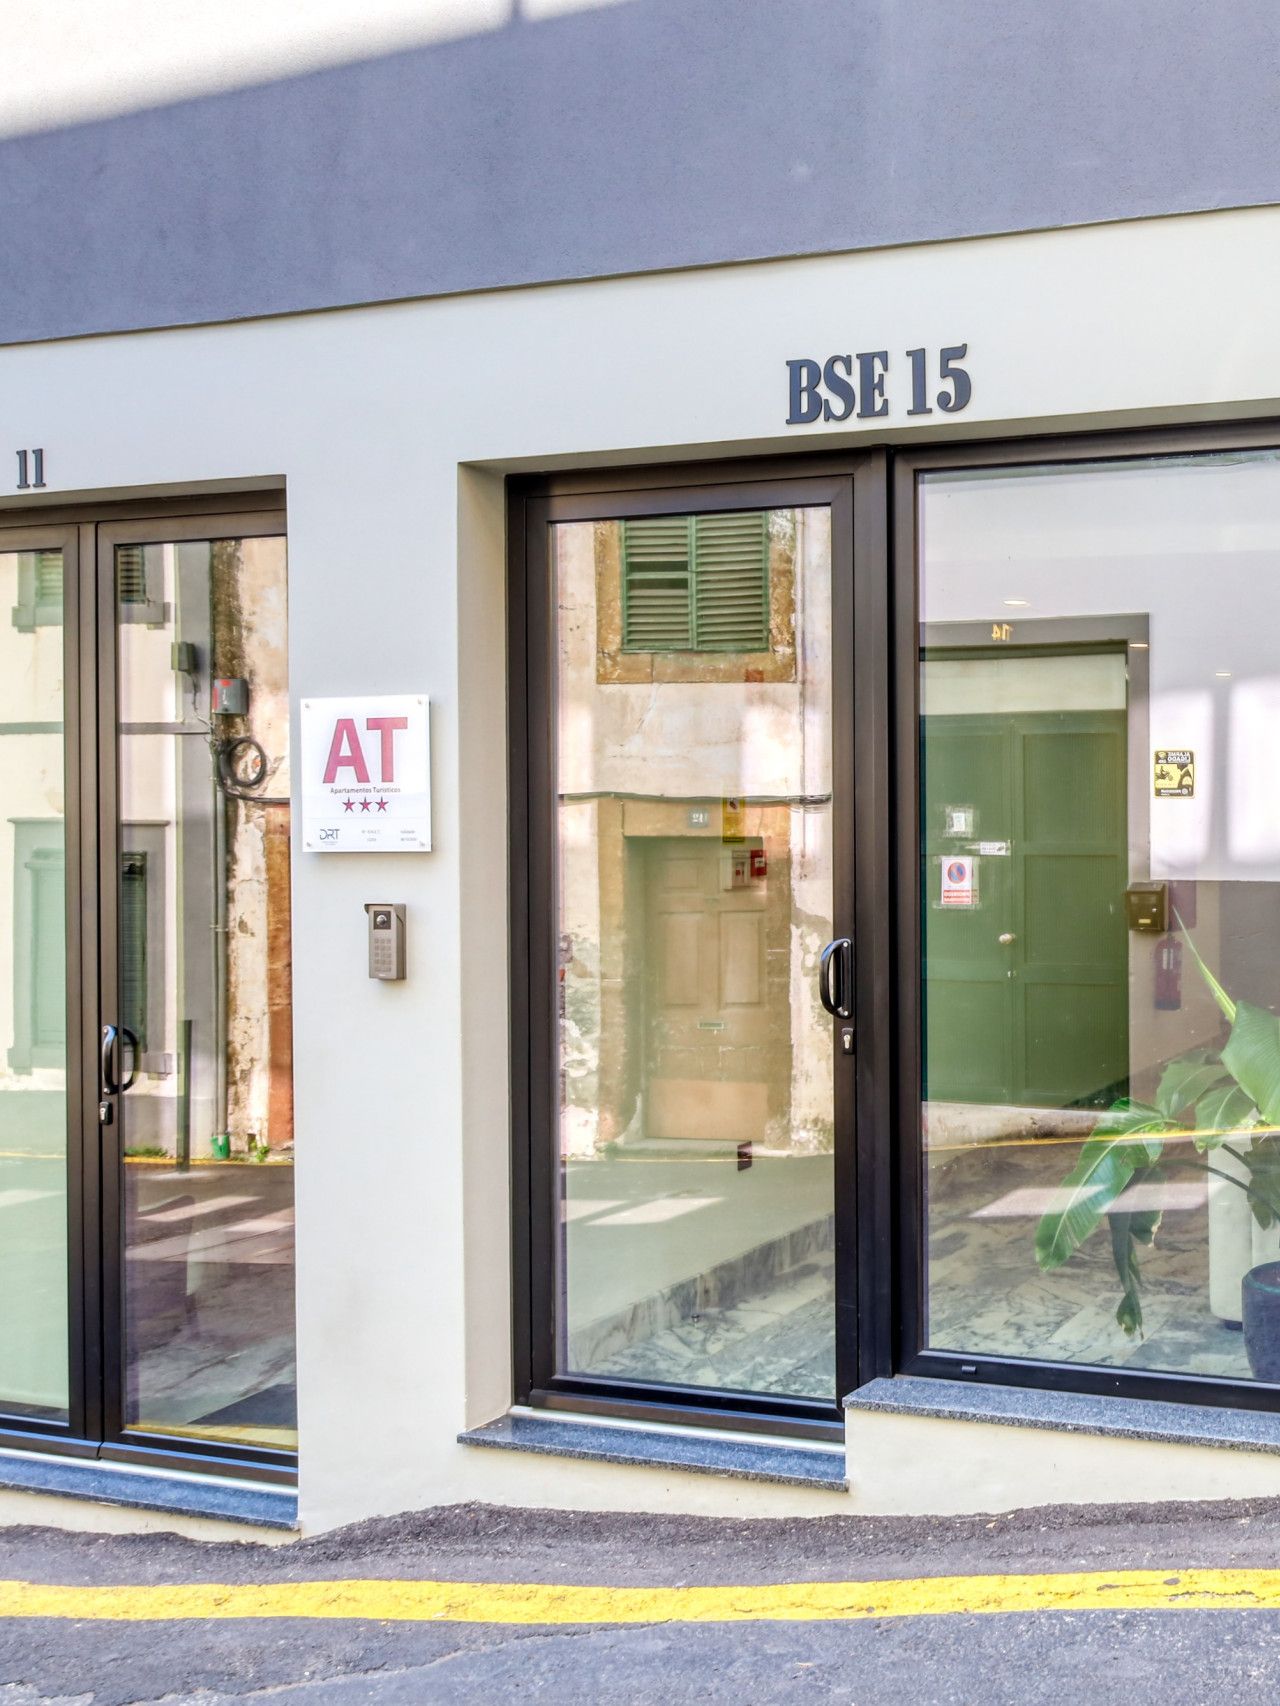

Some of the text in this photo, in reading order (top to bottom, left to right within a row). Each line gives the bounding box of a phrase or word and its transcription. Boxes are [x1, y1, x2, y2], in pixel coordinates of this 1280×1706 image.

[786, 343, 972, 425] BSE 15
[16, 448, 47, 489] 11
[322, 717, 408, 784] AT
[330, 787, 372, 795] Apartamentos
